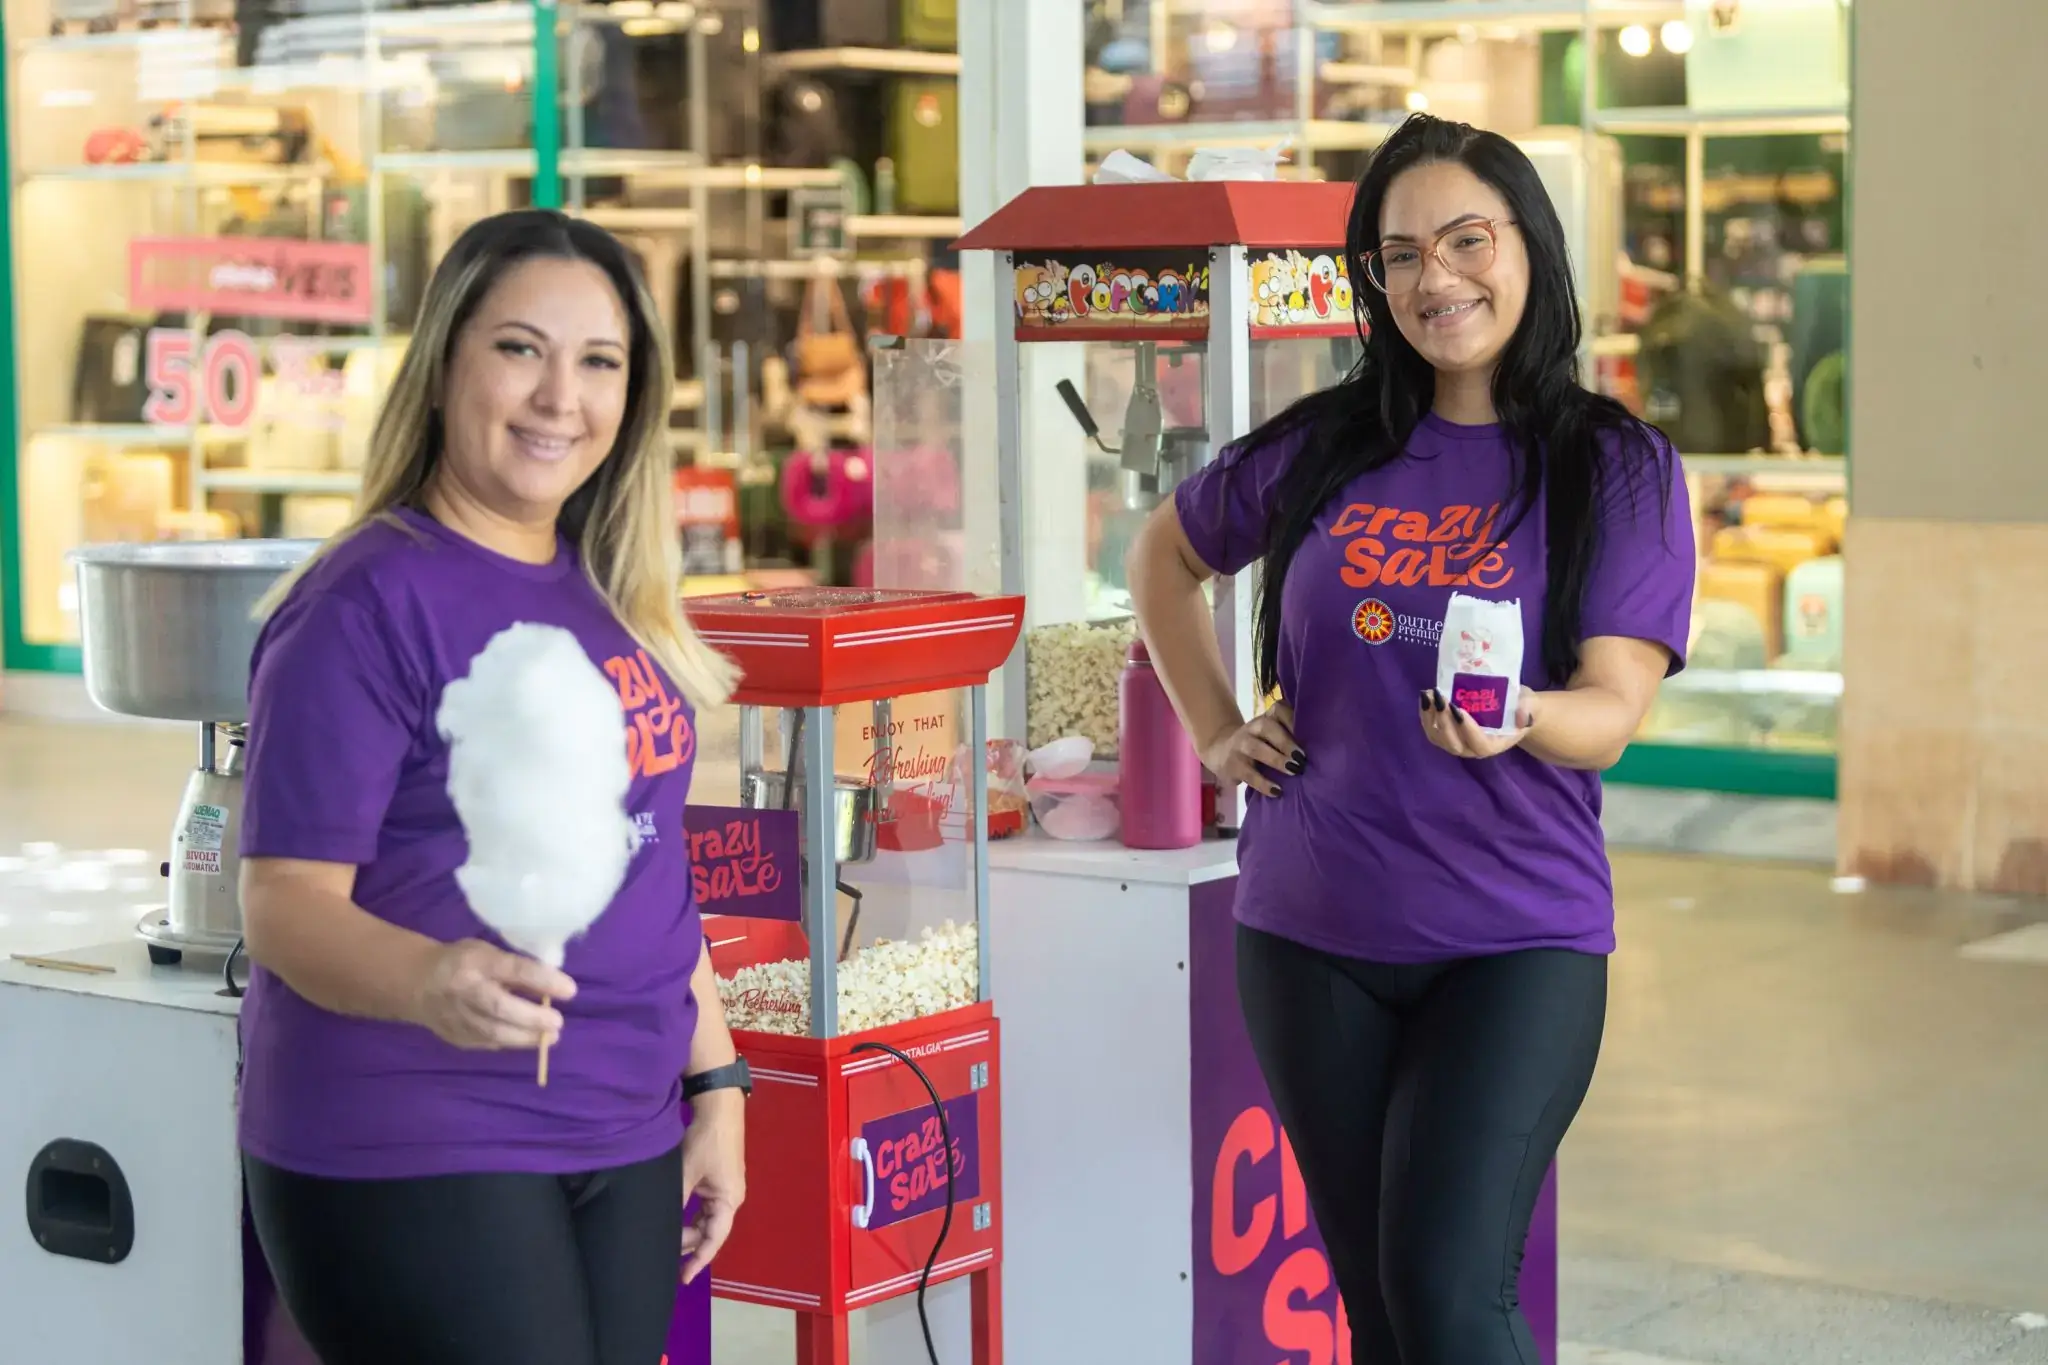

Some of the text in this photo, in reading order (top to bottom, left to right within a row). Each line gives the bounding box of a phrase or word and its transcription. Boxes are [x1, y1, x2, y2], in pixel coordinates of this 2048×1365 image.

[1308, 254, 1354, 318] PO
[142, 328, 261, 430] 50
[862, 715, 945, 741] ENJOY THAT
[863, 746, 947, 786] Refreshing
[185, 850, 219, 862] BIVOLT
